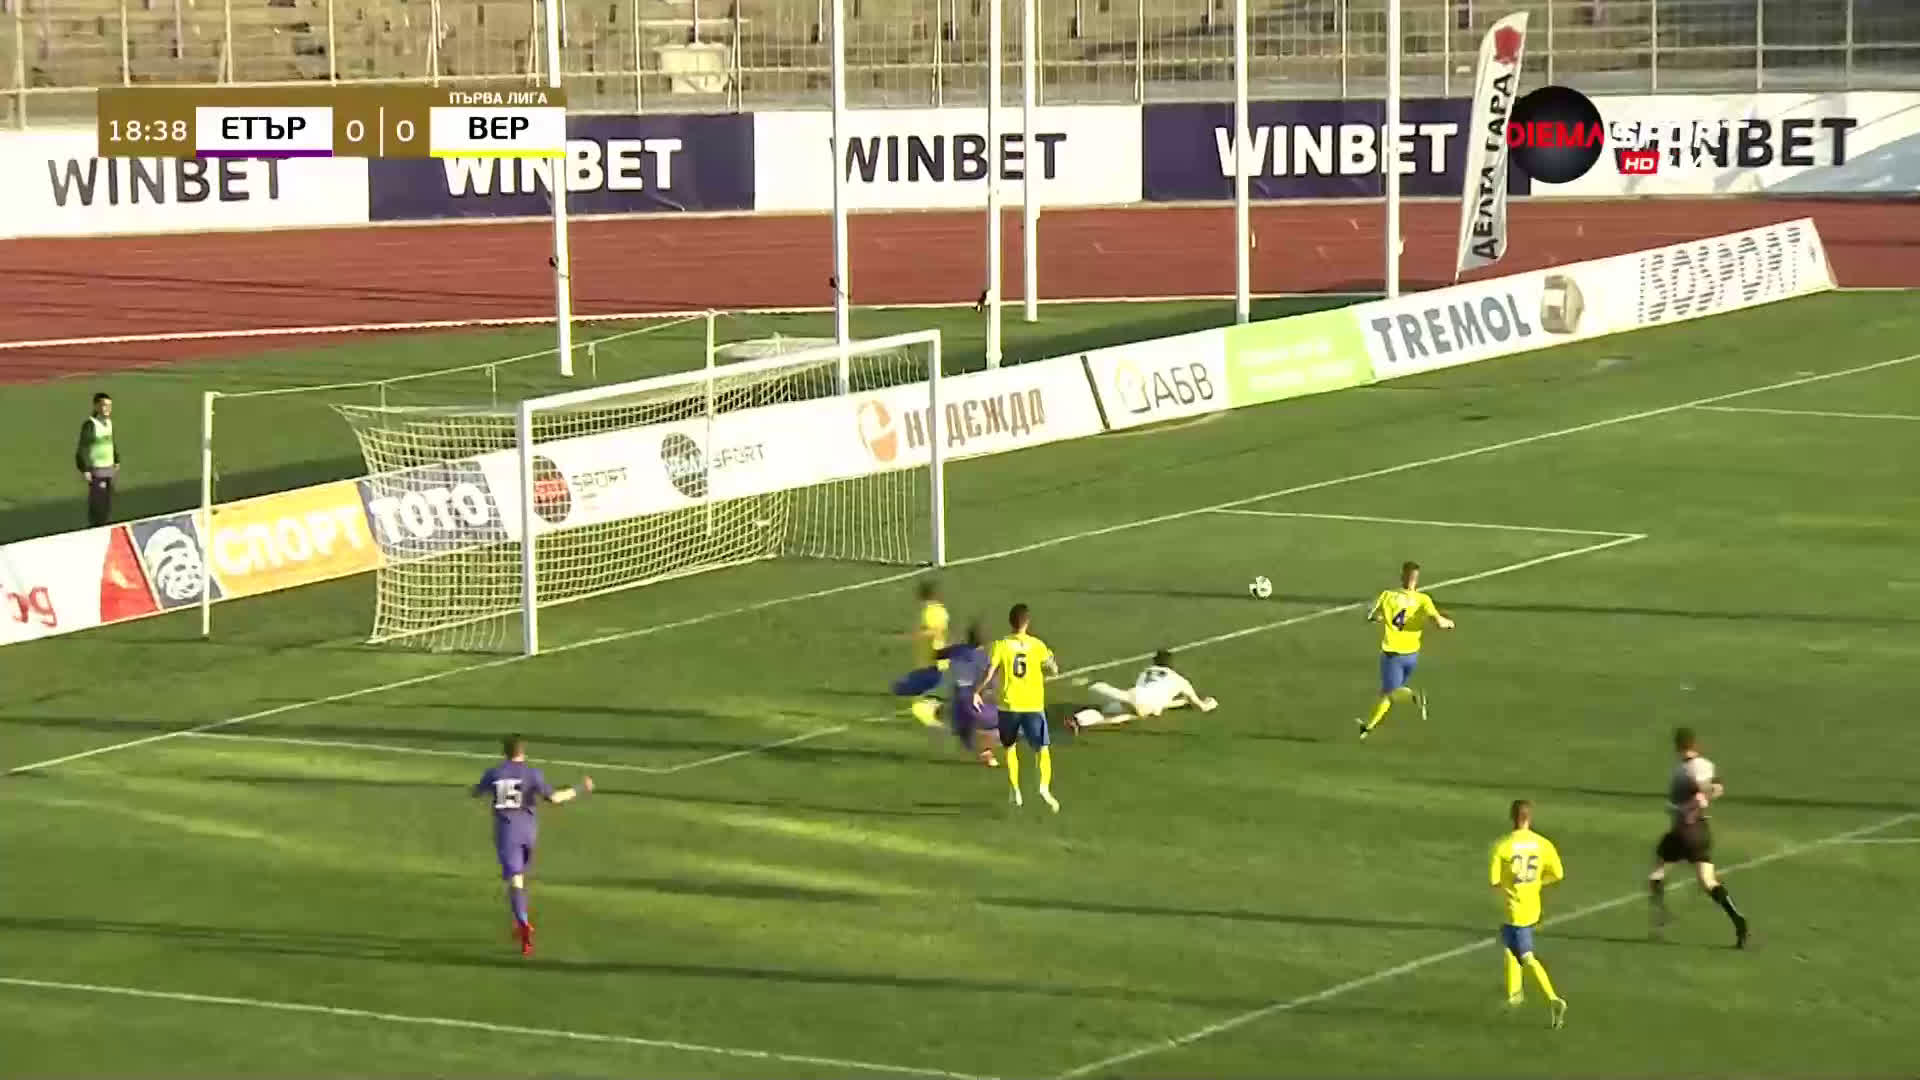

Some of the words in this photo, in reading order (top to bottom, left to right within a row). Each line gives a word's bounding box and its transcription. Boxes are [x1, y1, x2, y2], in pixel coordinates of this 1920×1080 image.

[1485, 72, 1514, 153] ГАРА
[442, 138, 683, 197] WINBET
[830, 132, 1068, 183] WINBET
[1214, 121, 1458, 179] WINBET
[47, 156, 283, 207] WINBET
[1636, 227, 1801, 323] ISOSPORT
[1370, 293, 1532, 362] TREMOL
[1152, 362, 1214, 408] АБВ
[214, 506, 363, 576] СПОРТ
[1392, 609, 1406, 631] 4
[1013, 653, 1027, 678] 6
